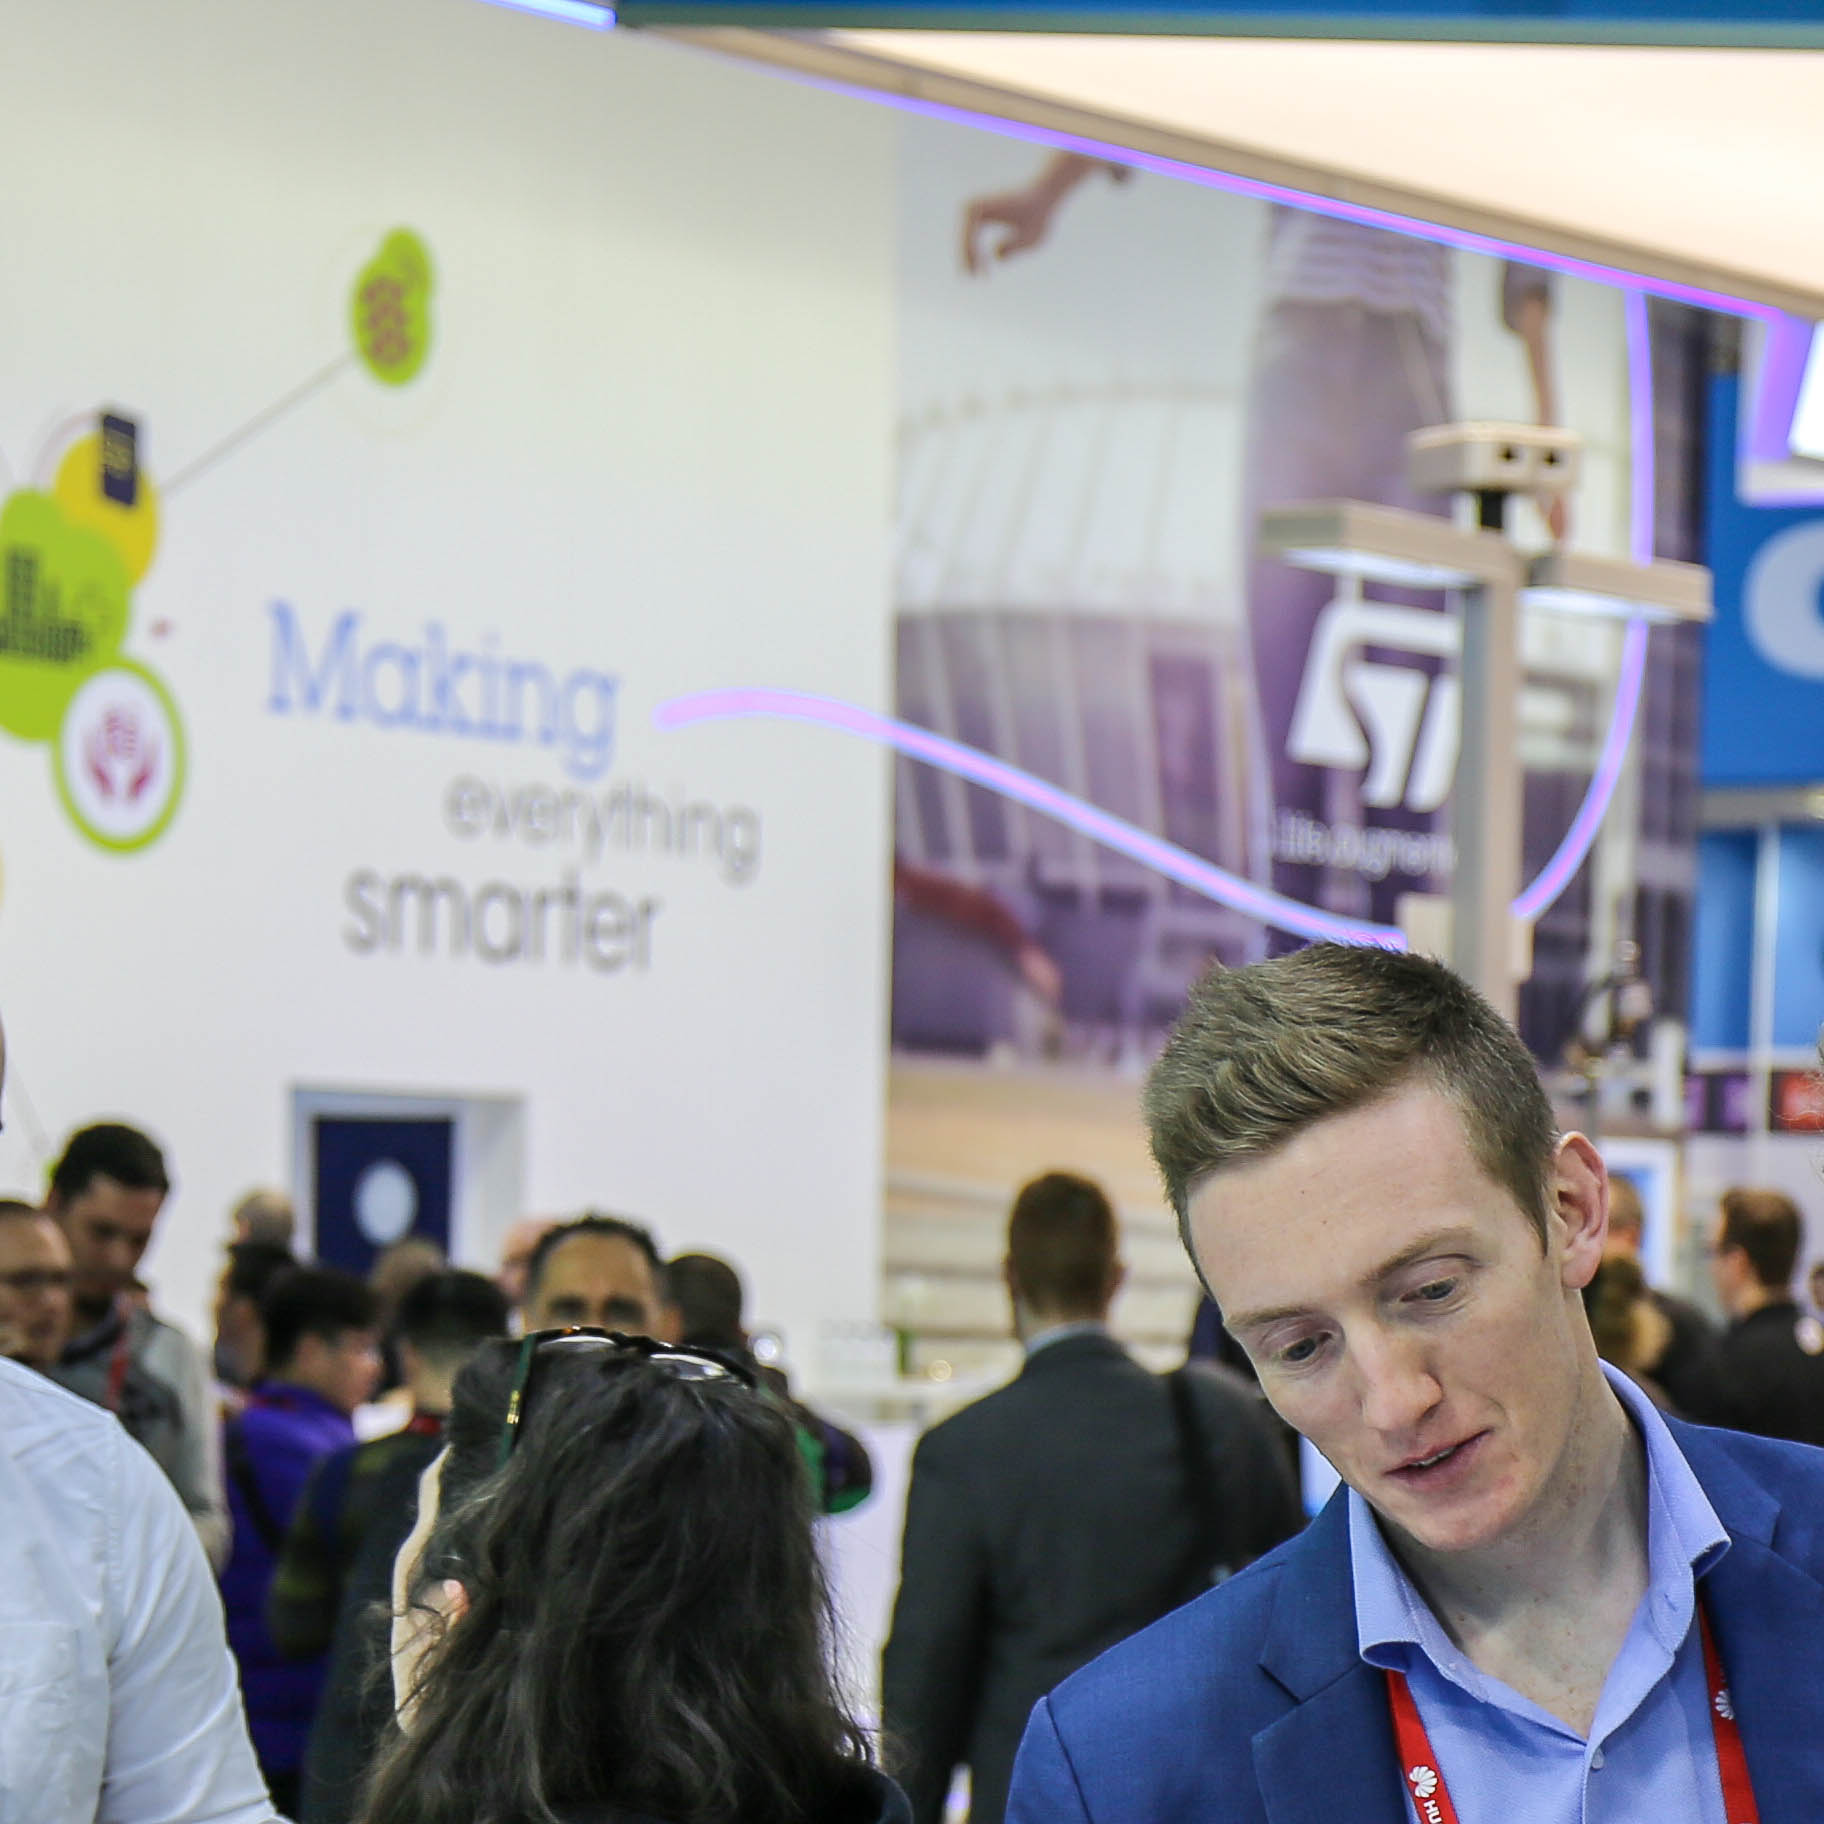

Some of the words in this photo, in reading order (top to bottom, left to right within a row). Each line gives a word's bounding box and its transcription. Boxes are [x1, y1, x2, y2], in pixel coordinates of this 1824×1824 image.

[266, 597, 620, 780] Making
[441, 772, 764, 887] everything
[341, 862, 660, 974] smarter
